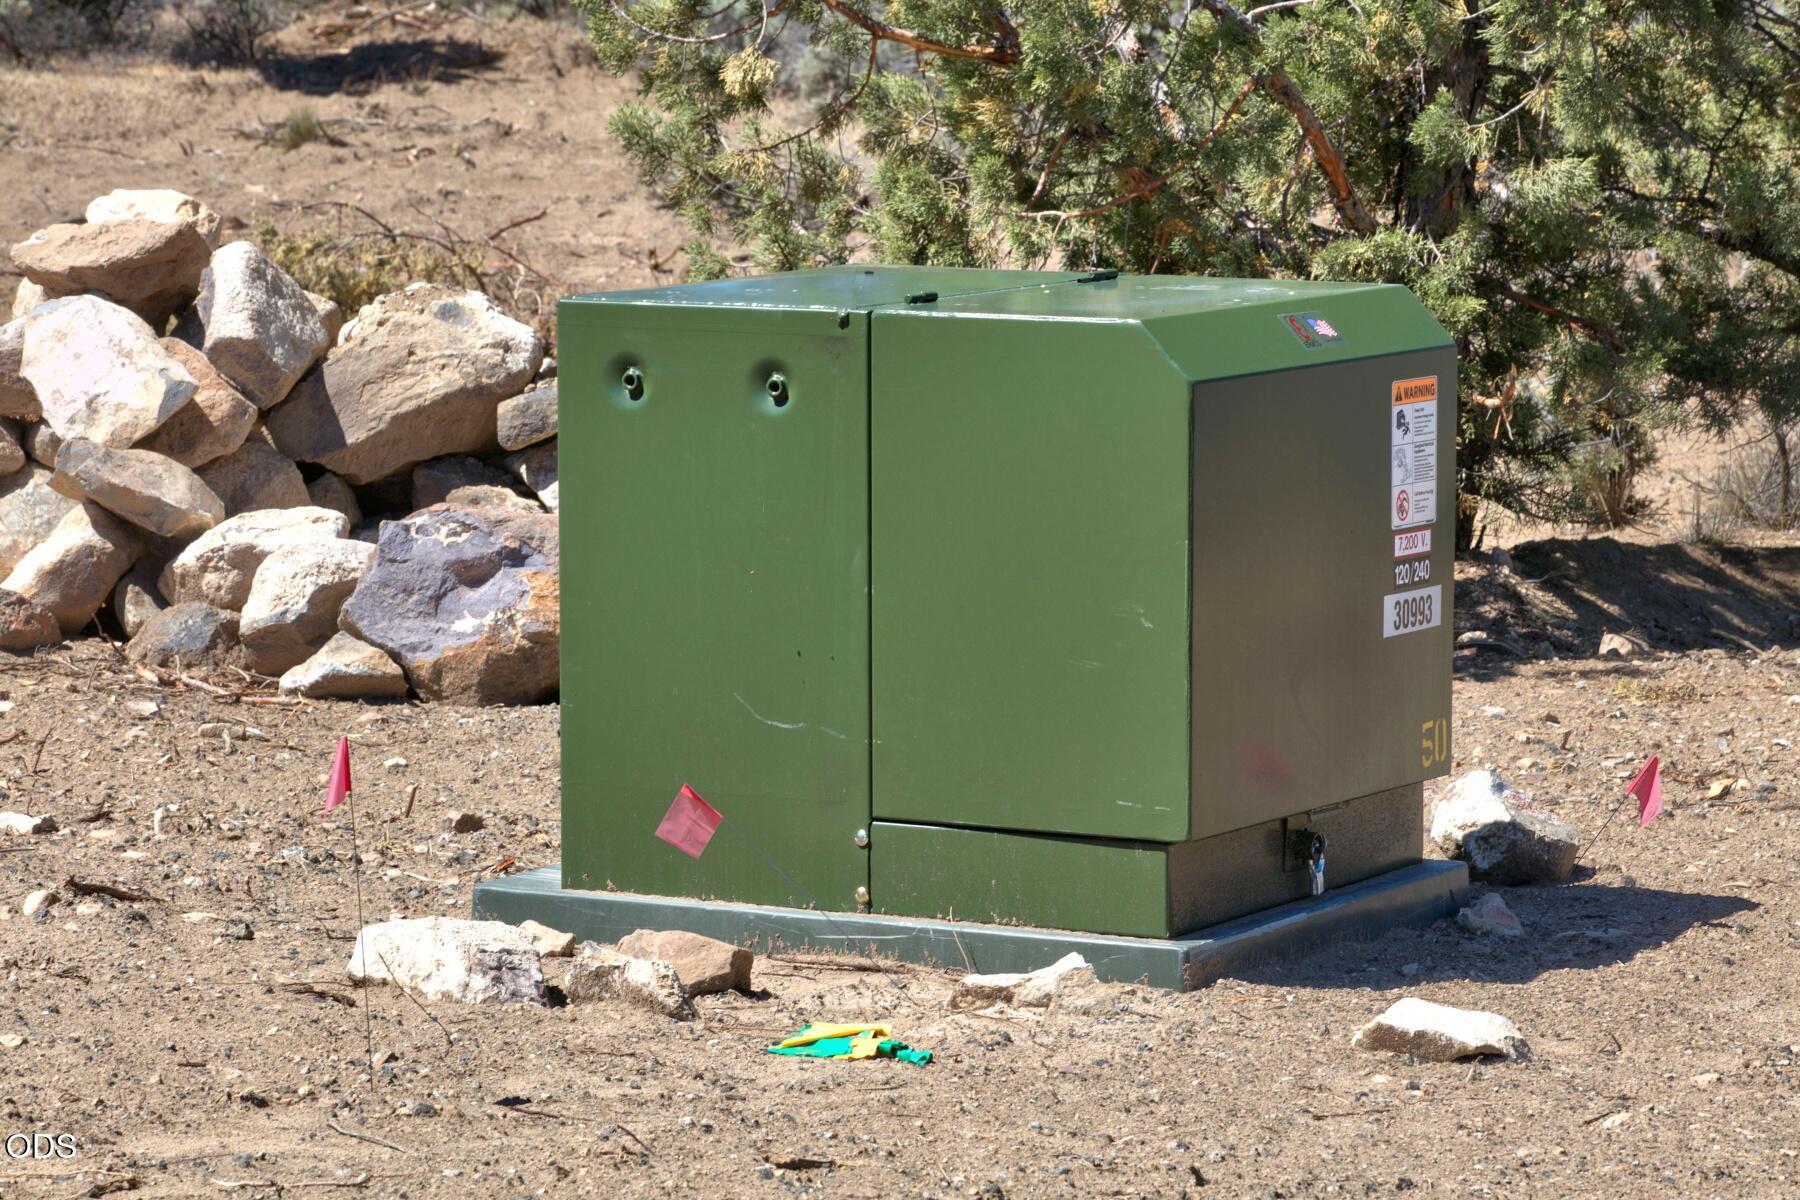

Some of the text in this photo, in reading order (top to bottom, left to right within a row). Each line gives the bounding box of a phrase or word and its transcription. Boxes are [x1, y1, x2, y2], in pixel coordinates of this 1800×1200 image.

[1404, 383, 1435, 400] WARNING
[1395, 560, 1430, 585] 120/240
[1394, 594, 1433, 631] 30993
[1422, 718, 1447, 768] 50
